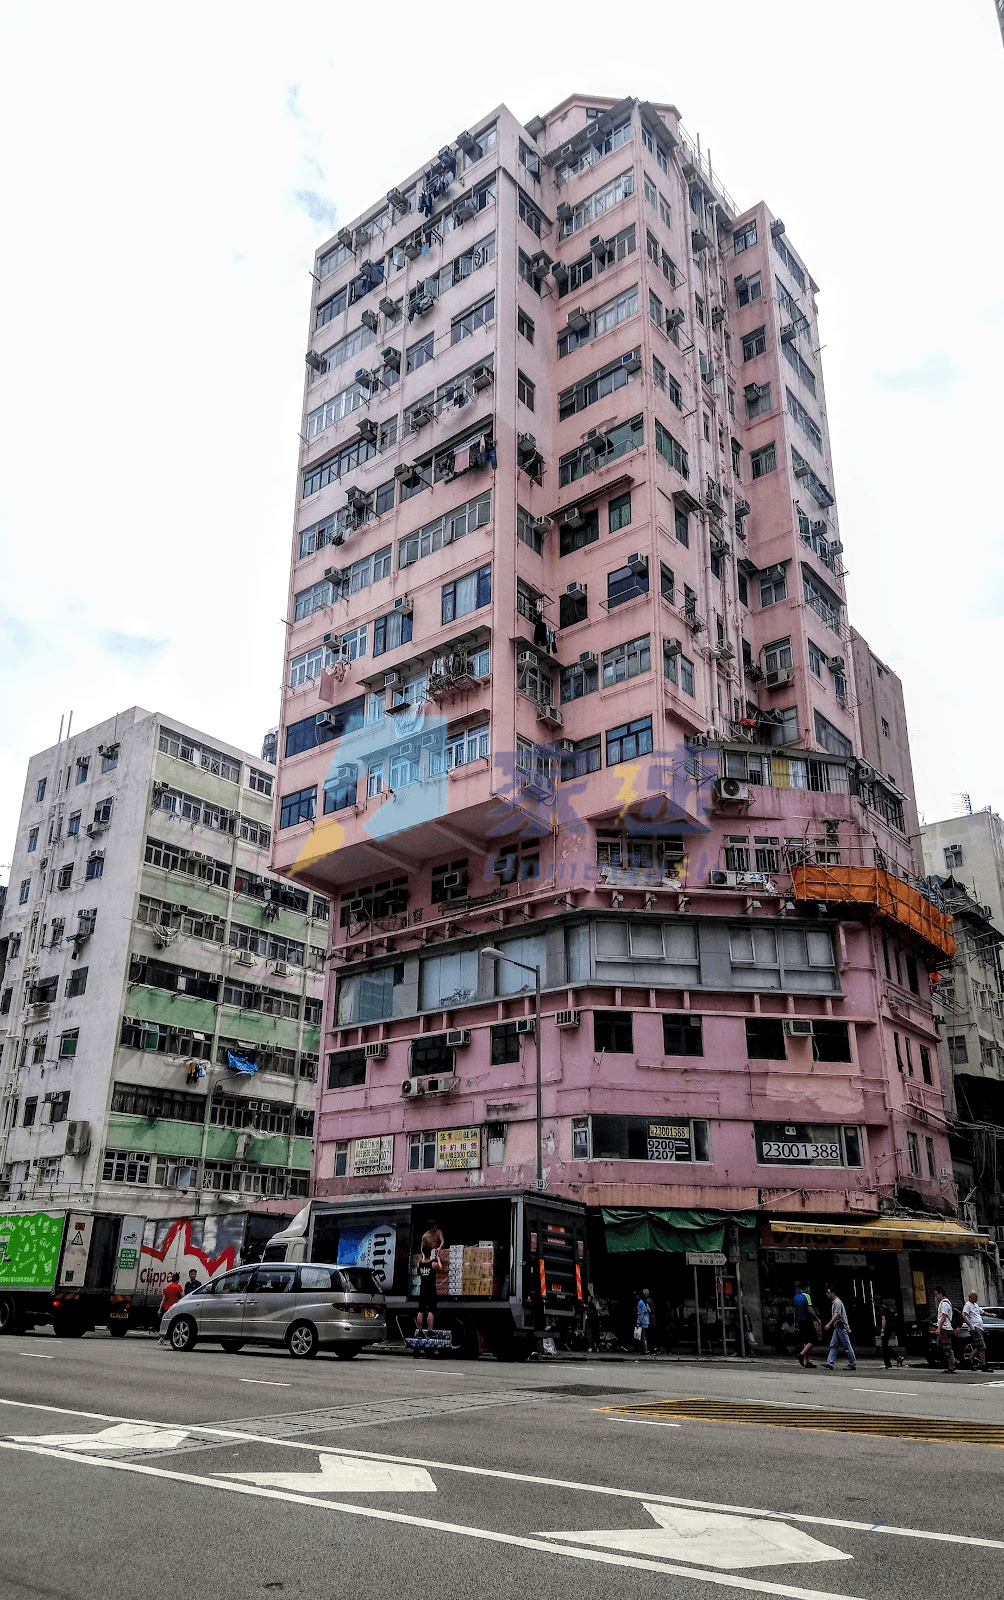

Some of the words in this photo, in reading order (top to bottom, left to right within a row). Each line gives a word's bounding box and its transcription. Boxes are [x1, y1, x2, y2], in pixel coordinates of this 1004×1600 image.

[654, 1126, 686, 1138] 23001388
[648, 1139, 674, 1150] 9200
[763, 1142, 839, 1159] 23001388
[648, 1149, 675, 1160] 7207
[372, 1232, 392, 1283] hite
